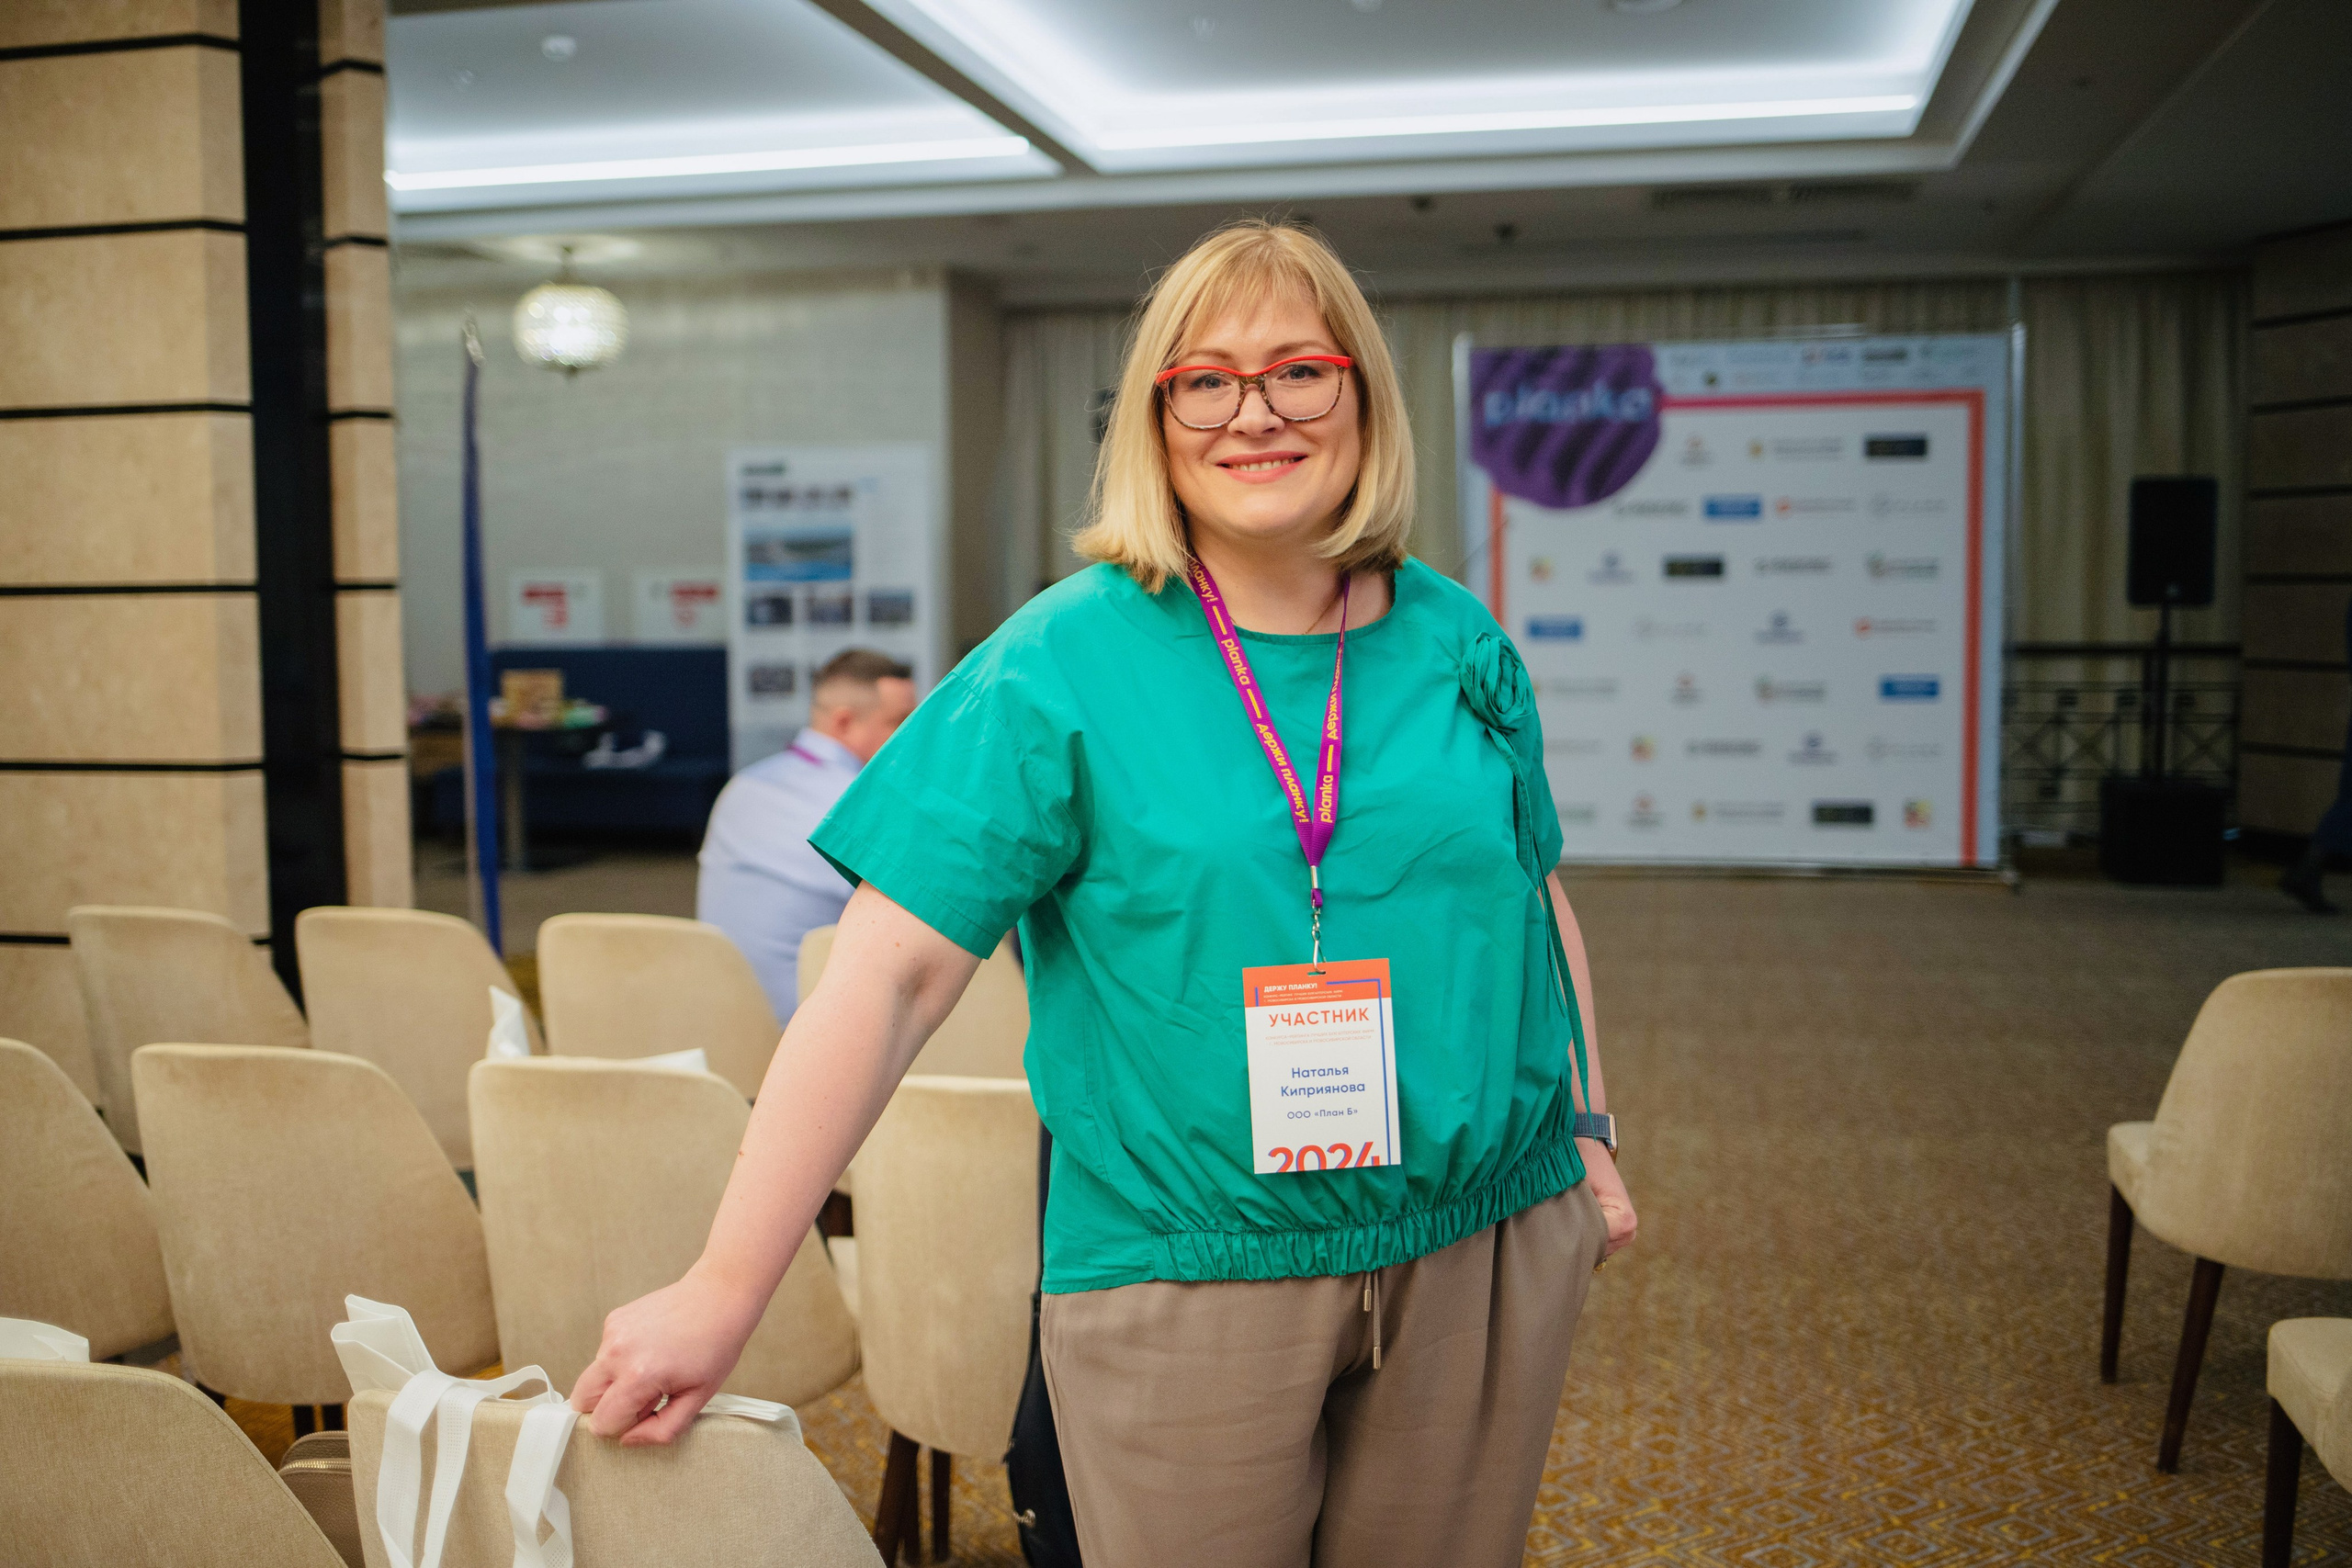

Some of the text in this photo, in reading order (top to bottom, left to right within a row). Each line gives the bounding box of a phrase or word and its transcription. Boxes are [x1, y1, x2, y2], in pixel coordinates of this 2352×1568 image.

[1221, 638, 1250, 685] planka
[1281, 768, 1309, 823] планку!
[1318, 774, 1333, 823] planka
[1264, 983, 1317, 993] ДЕРЖУ ПЛАНКУ!
[1269, 1008, 1370, 1028] УЧАСТНИК
[1292, 1066, 1350, 1079] Наталья
[1281, 1083, 1366, 1098] Киприянова
[1286, 1108, 1358, 1120] ООО «План Б»
[1268, 1141, 1380, 1173] 2024
